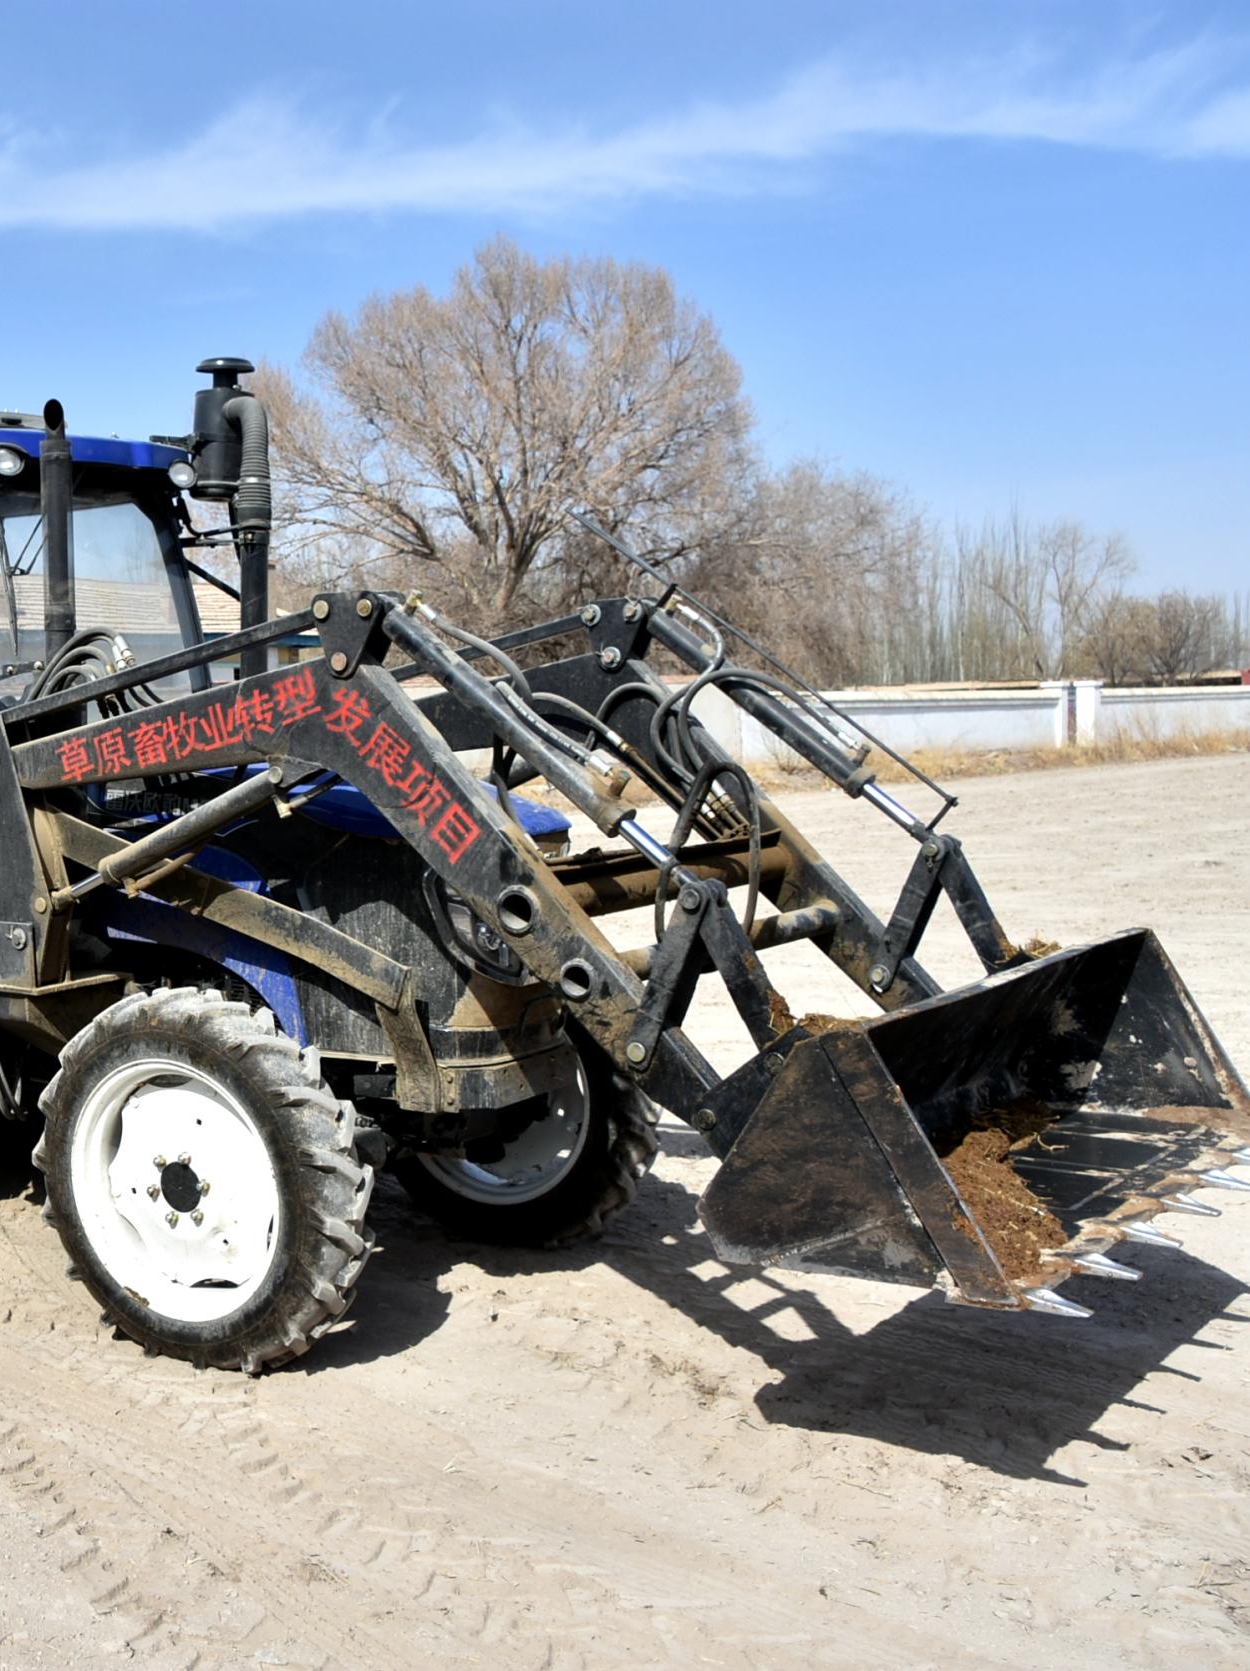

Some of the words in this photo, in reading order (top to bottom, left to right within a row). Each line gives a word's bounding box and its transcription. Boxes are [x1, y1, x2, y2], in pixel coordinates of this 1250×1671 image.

[55, 667, 484, 865] 草原畜牧业转型发展项目
